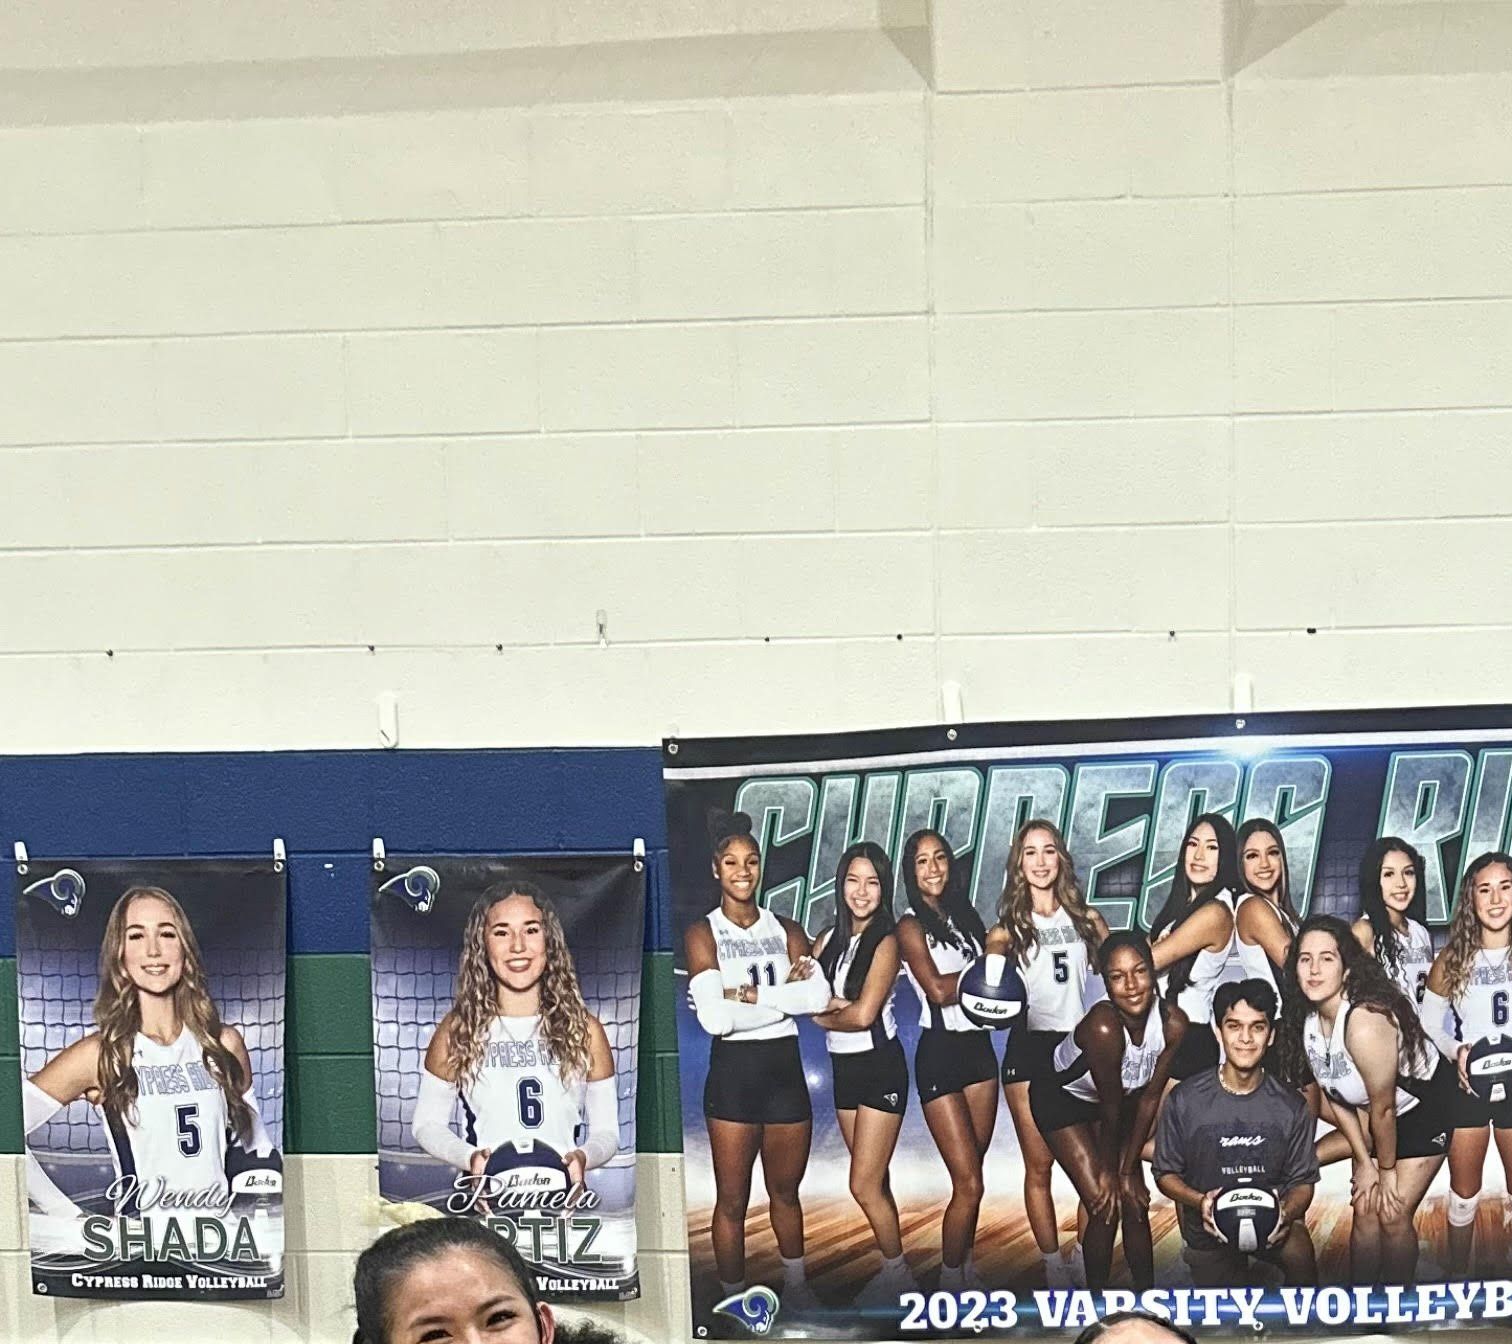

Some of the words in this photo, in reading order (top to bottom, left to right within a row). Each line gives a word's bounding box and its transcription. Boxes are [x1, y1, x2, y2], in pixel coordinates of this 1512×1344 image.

[734, 756, 1332, 941] CYPRESS
[747, 961, 776, 987] 11
[1052, 949, 1070, 983] 5
[1491, 989, 1510, 1027] 6
[516, 1076, 544, 1129] 6
[175, 1103, 202, 1157] 5
[105, 1175, 237, 1217] Wendy
[447, 1174, 600, 1213] Pamela
[82, 1215, 262, 1264] SHADA
[487, 1215, 602, 1264] RTIZ
[71, 1273, 138, 1289] CYPRESS
[142, 1274, 183, 1289] RIDGE
[186, 1274, 267, 1289] VOLLEYBALL
[536, 1276, 619, 1291] VOLLEYBALL
[900, 1290, 1017, 1330] 2023
[1033, 1286, 1264, 1328] VARSITY
